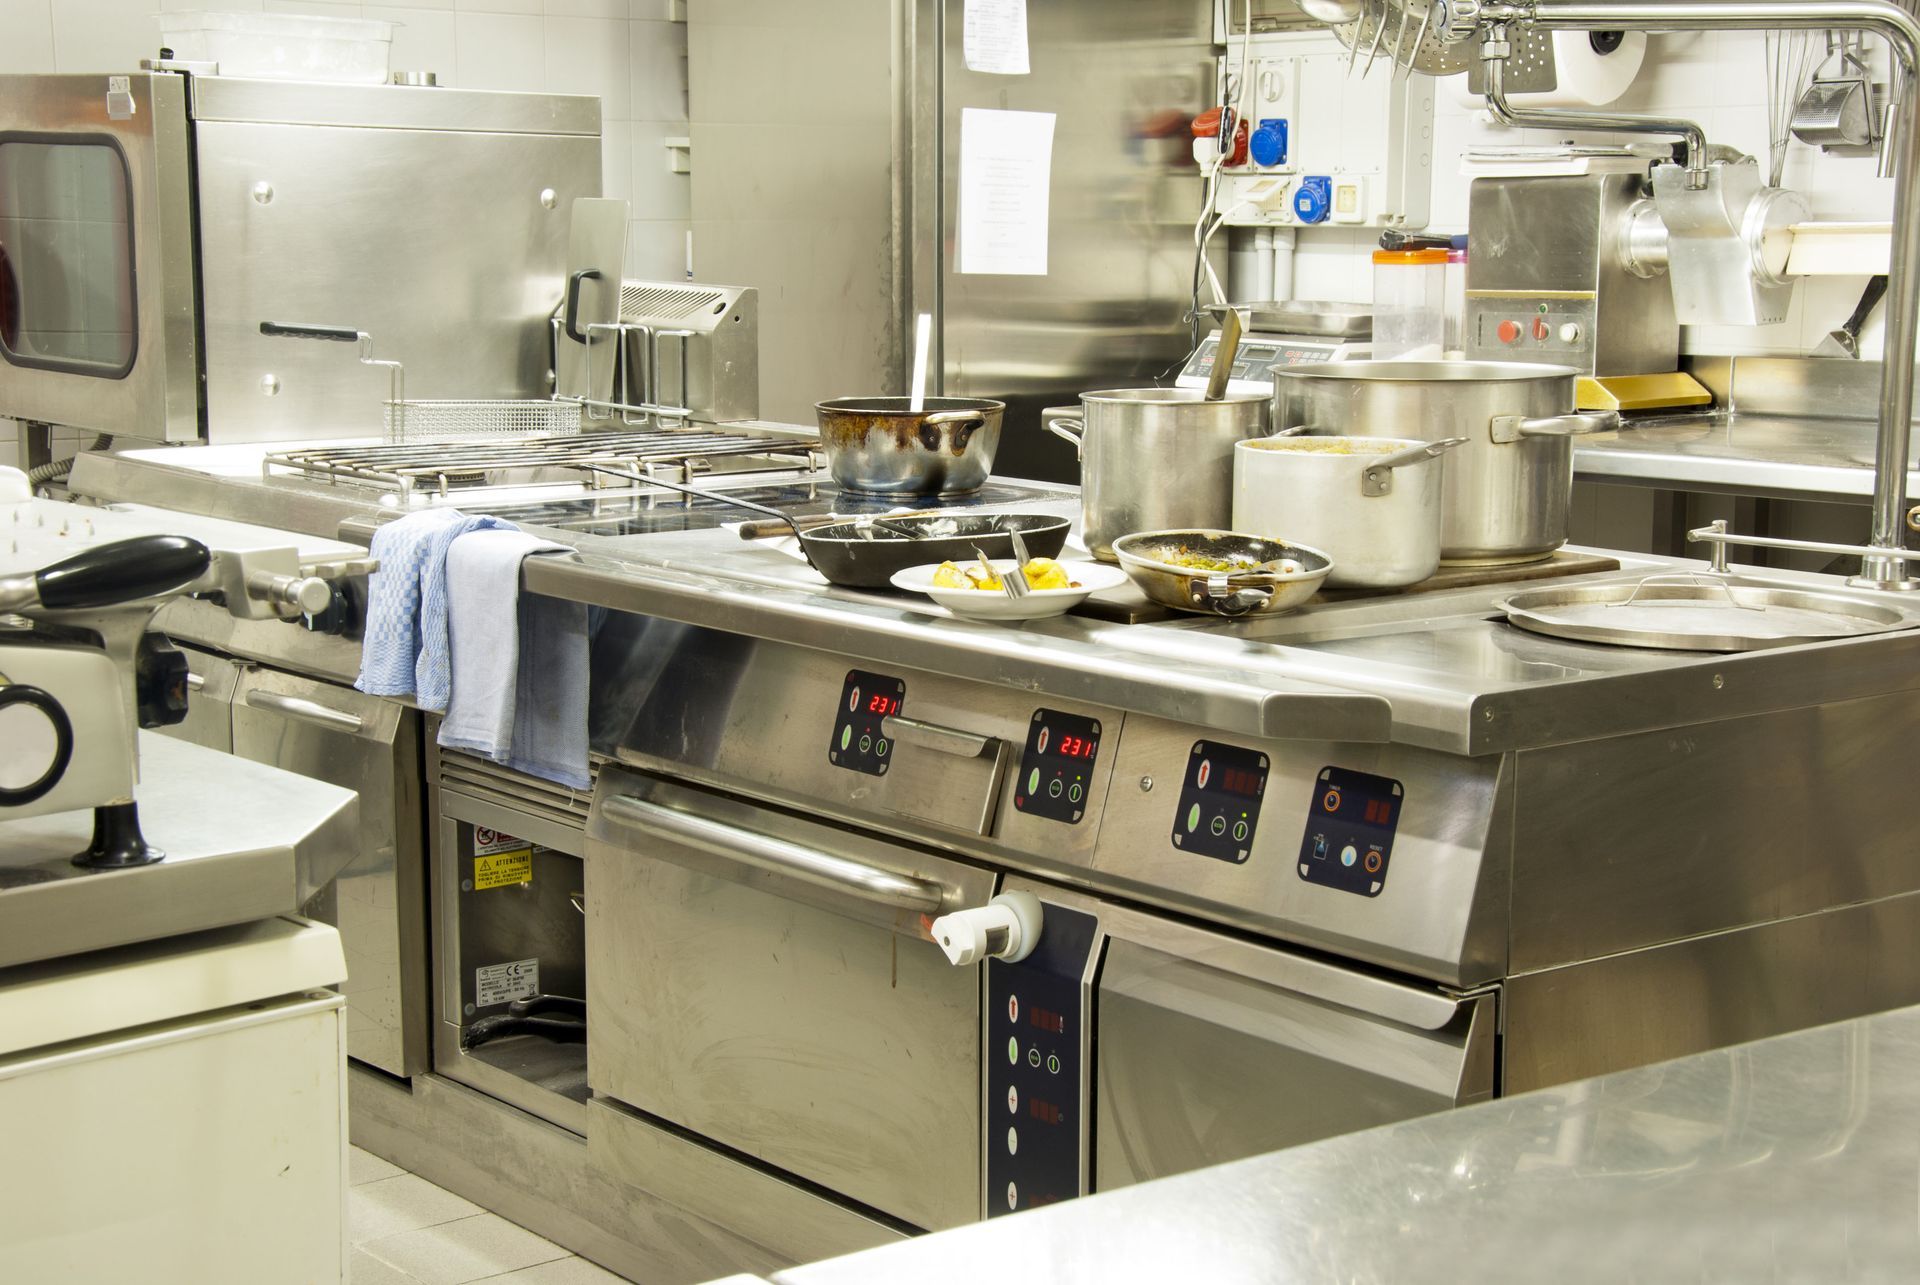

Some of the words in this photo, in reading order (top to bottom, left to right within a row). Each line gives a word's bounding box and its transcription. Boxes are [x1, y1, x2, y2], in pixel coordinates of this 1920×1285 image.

[869, 696, 897, 714] 231
[1060, 737, 1092, 757] 231
[496, 855, 528, 866] ATTENZIONE
[506, 964, 520, 976] CE
